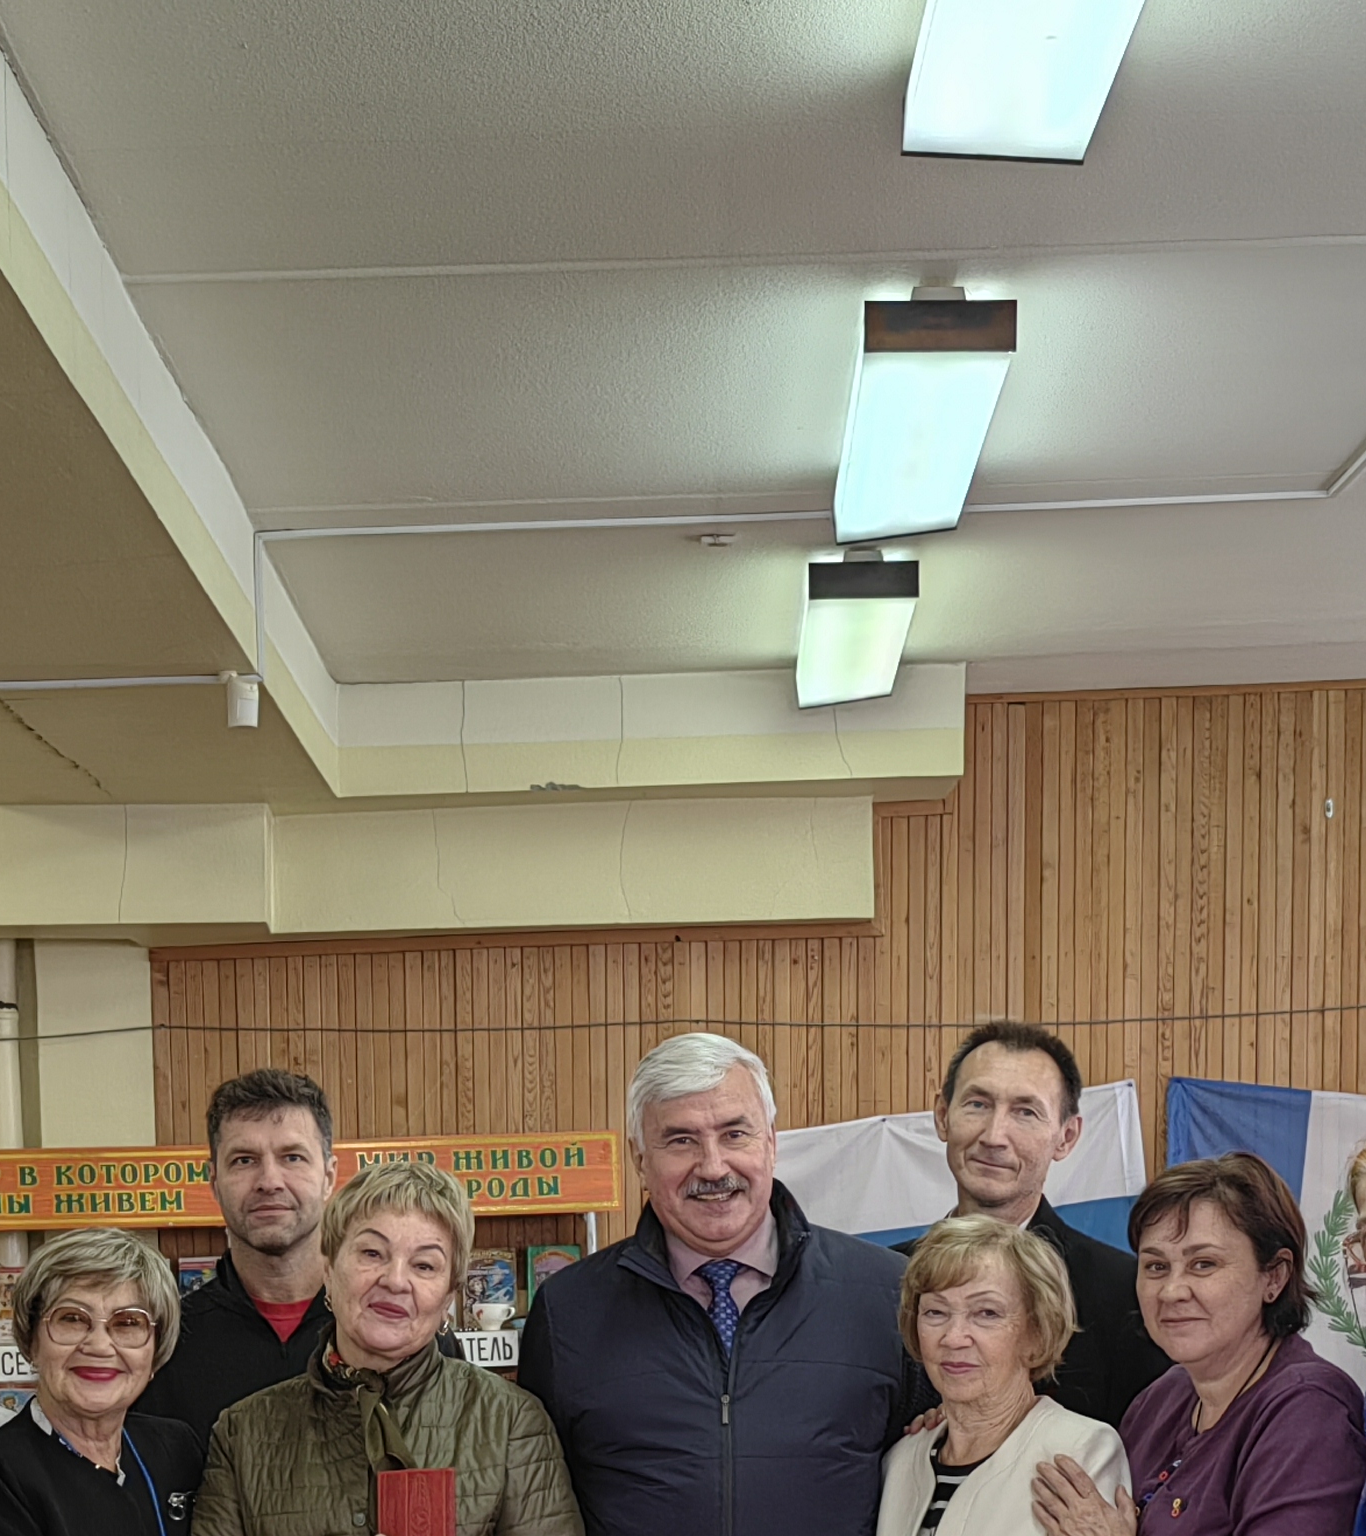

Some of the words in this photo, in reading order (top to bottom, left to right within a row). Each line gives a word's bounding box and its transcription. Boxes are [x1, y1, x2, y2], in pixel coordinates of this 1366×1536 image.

[452, 1142, 586, 1172] ЖИВОЙ
[19, 1164, 38, 1188] В
[54, 1160, 211, 1187] КОТОРОМ
[466, 1175, 561, 1200] РОДЫ
[54, 1189, 184, 1216] ЖИВЕМ
[1, 1351, 29, 1376] СЕ
